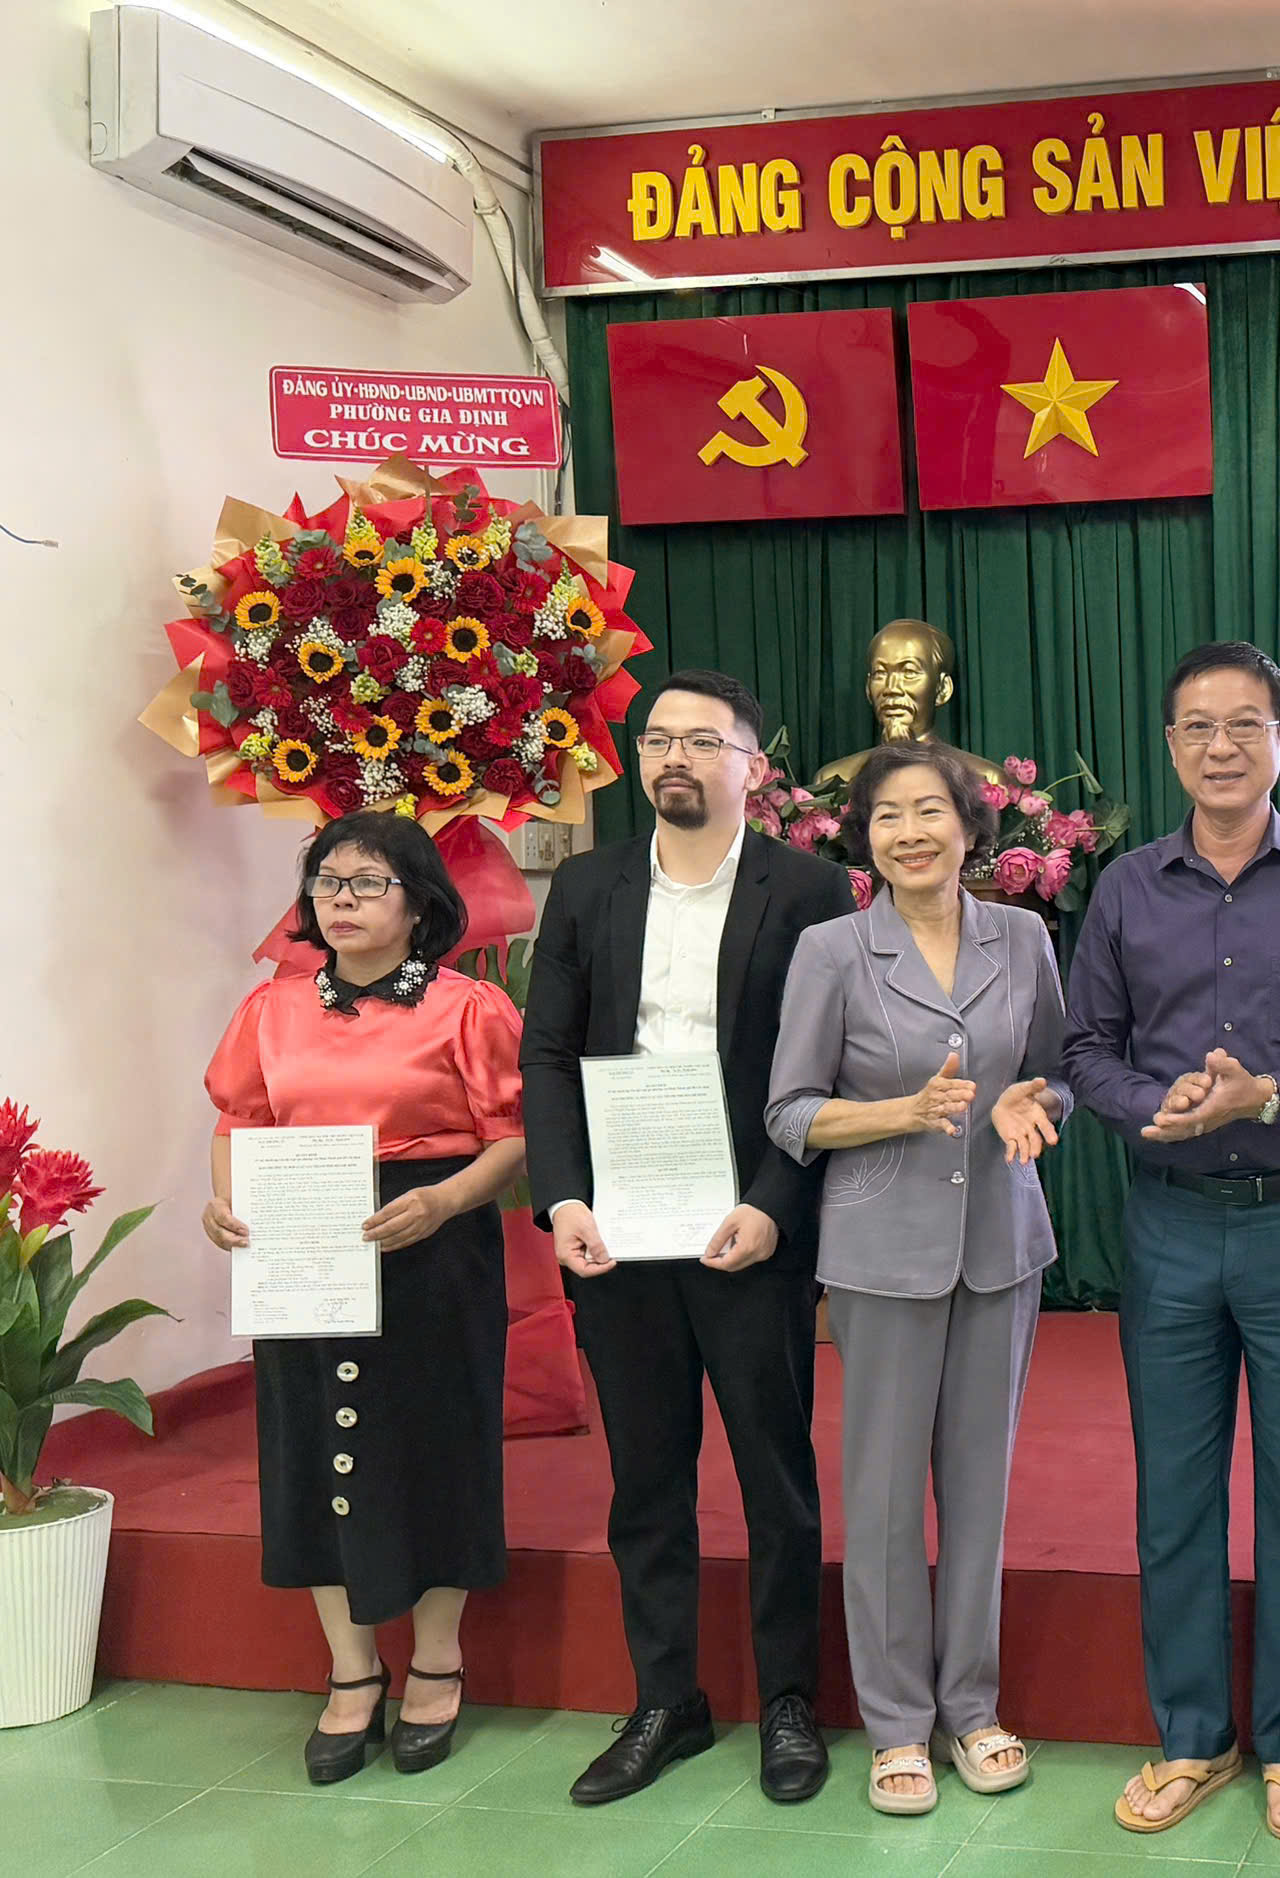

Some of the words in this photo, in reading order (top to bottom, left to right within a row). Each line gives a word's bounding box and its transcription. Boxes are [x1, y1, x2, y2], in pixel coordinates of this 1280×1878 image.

[627, 142, 804, 243] ĐẢNG
[828, 134, 1007, 242] CỘNG
[1032, 112, 1166, 214] SẢN
[282, 375, 328, 397] ĐẢNG
[329, 403, 411, 422] PHƯỜNG
[418, 408, 453, 425] GIA
[459, 409, 508, 427] ĐỊNH
[303, 427, 408, 451] CHÚC
[417, 433, 530, 456] MỪNG
